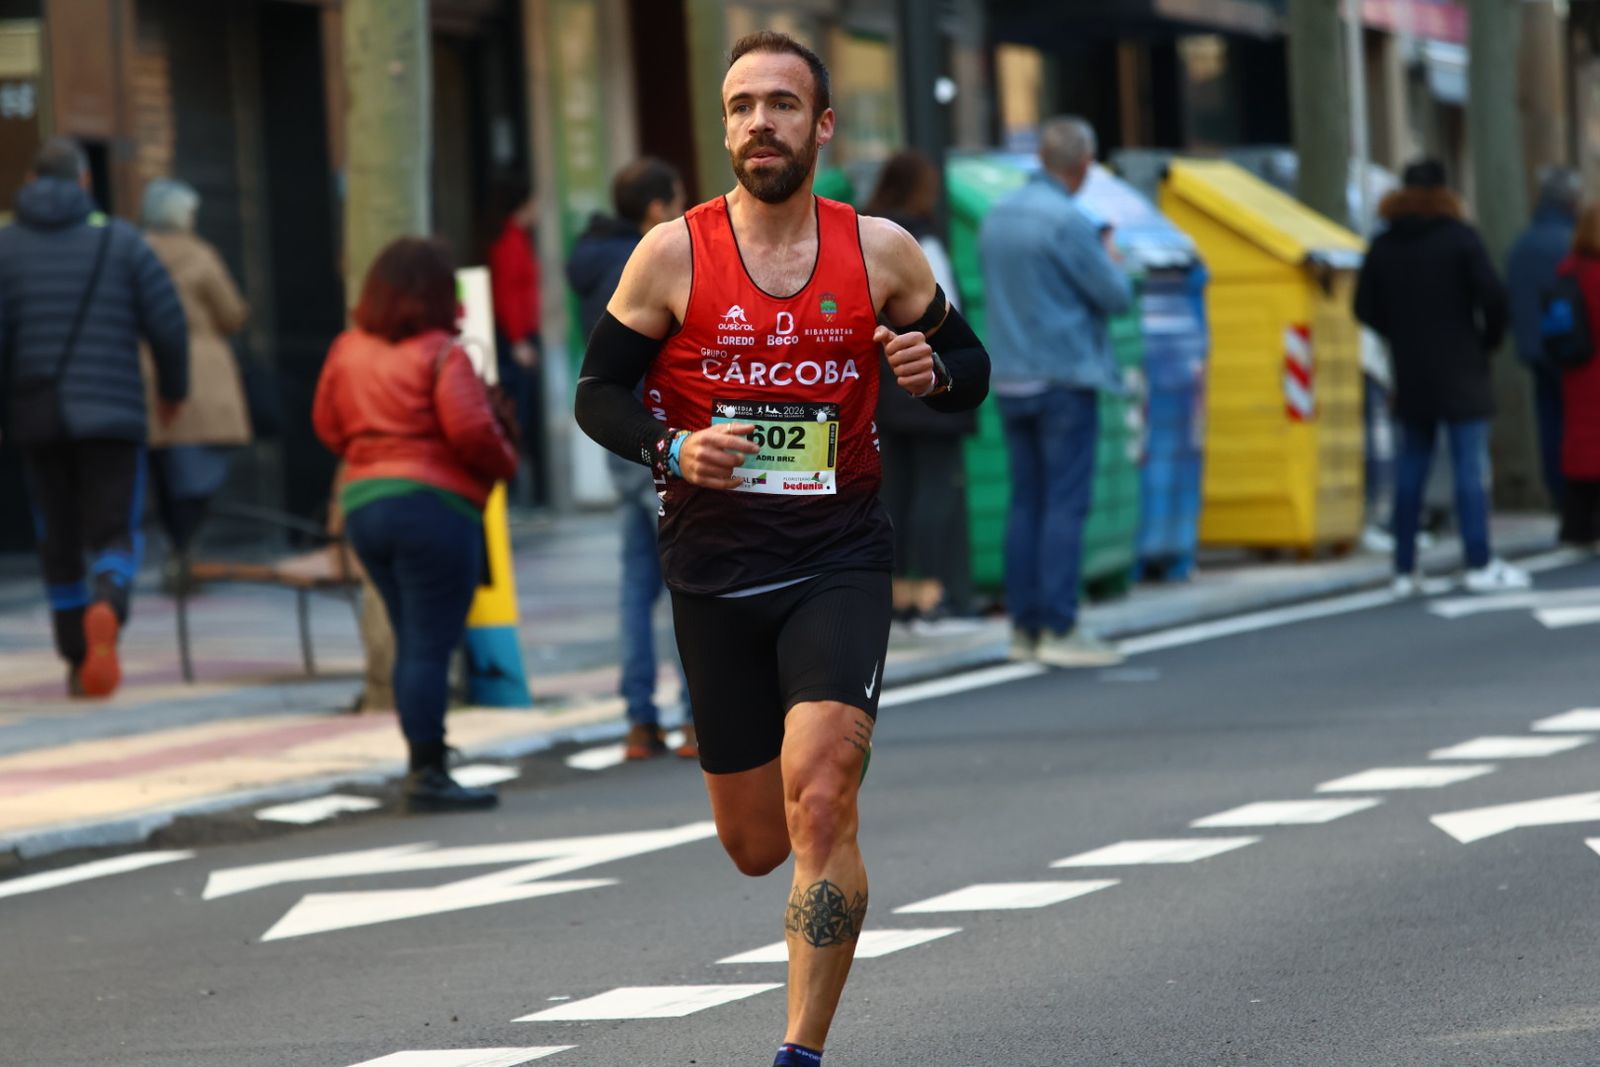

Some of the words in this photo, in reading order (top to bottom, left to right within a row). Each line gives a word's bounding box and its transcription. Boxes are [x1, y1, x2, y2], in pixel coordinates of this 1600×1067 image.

[717, 336, 755, 345] LOREDO
[767, 335, 799, 346] Beco
[700, 347, 728, 358] GRUPO
[701, 354, 860, 385] CÁRCOBA
[783, 406, 805, 415] 2026
[747, 424, 806, 450] 602
